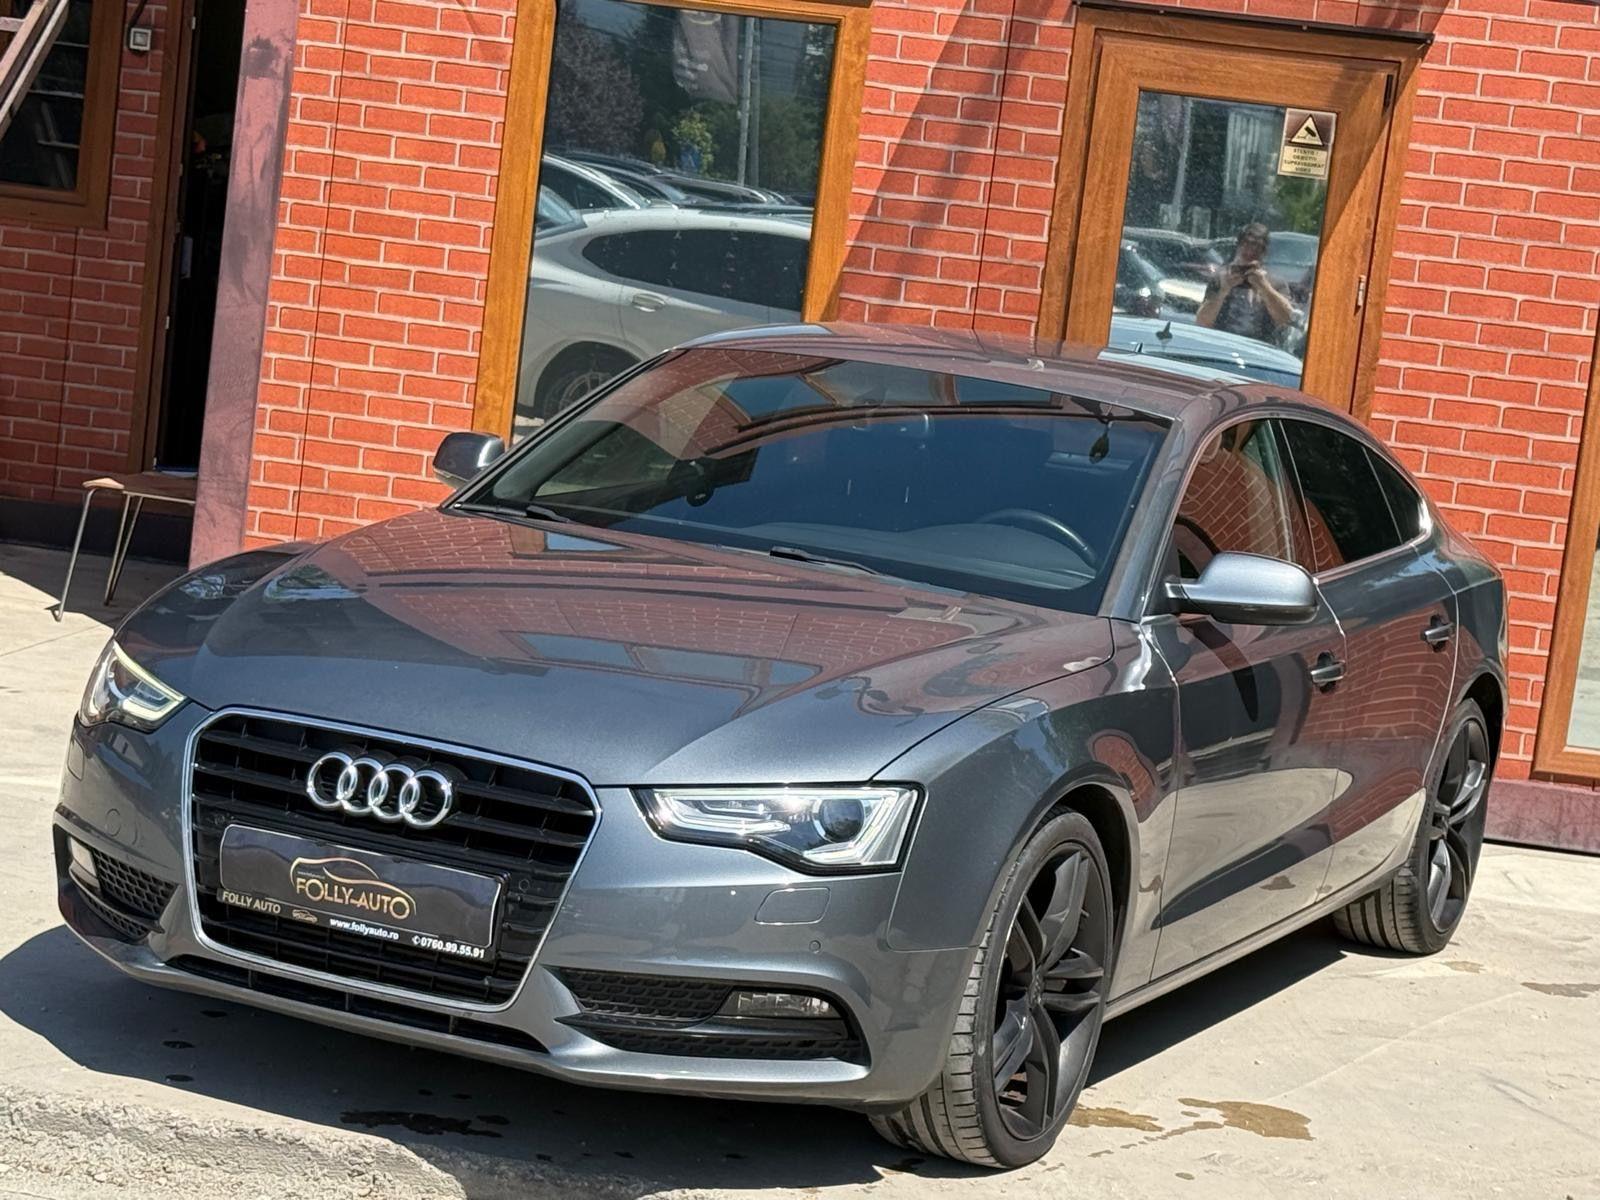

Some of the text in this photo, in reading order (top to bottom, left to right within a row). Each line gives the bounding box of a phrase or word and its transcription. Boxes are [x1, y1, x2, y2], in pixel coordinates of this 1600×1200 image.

[222, 891, 282, 915] FOLLY AUTO
[329, 917, 400, 940] www.follyauto.ro
